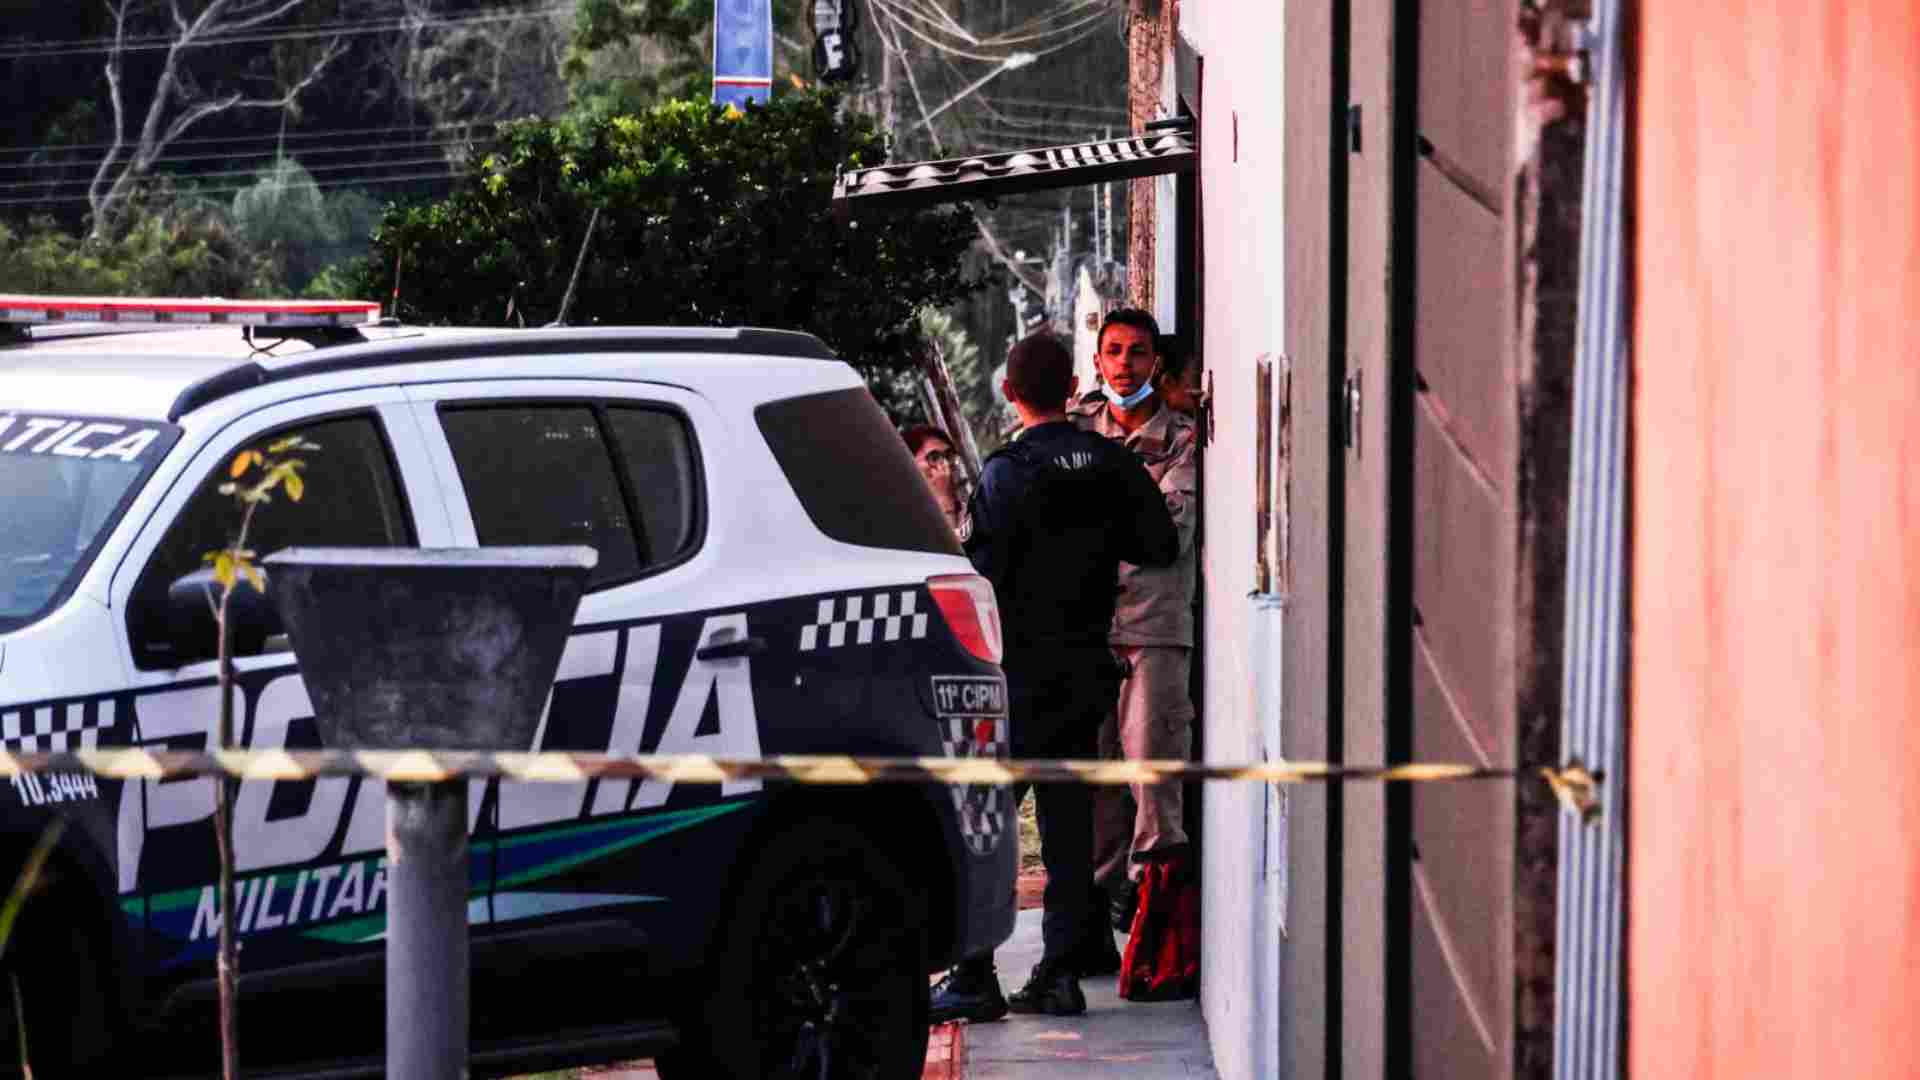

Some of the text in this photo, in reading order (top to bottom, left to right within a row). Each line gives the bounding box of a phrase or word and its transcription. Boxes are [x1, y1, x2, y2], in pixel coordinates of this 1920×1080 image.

[0, 412, 160, 462] TICA
[962, 684, 1001, 712] CIPM
[116, 612, 763, 893] POCIA
